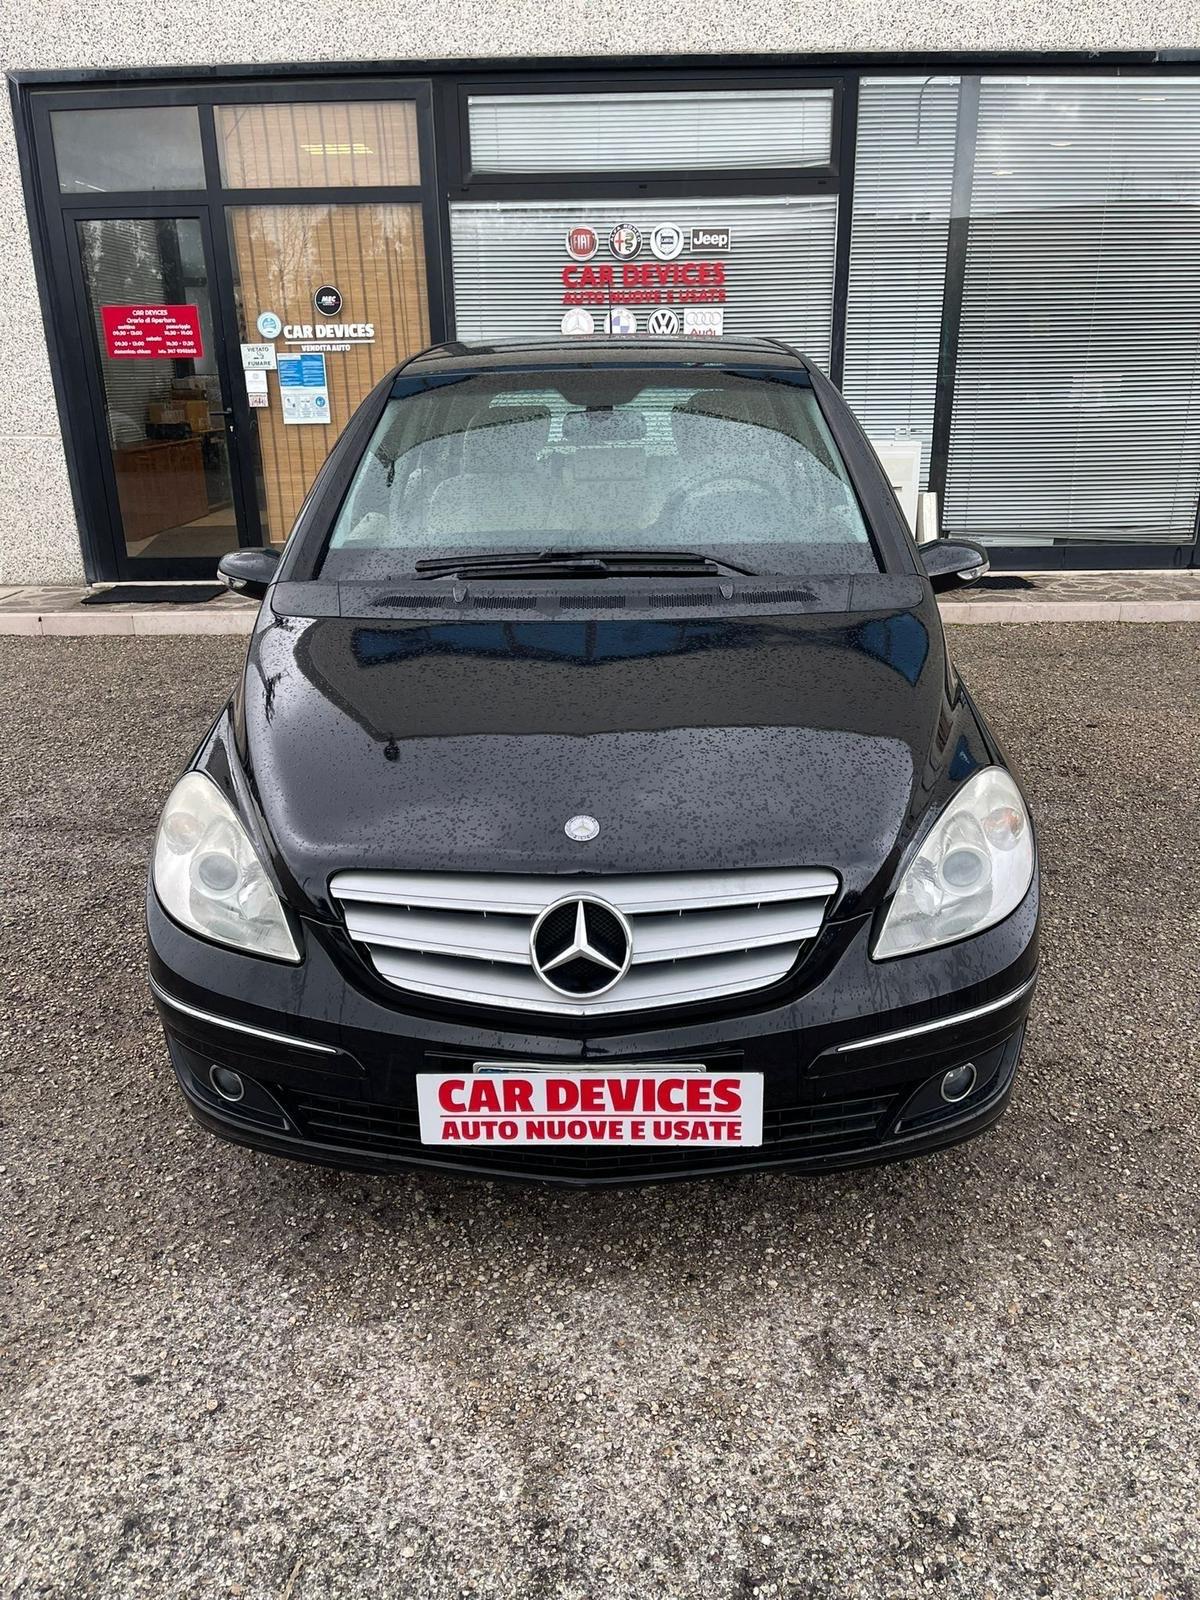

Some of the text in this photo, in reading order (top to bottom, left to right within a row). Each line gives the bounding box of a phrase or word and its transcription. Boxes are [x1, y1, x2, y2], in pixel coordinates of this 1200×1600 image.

[573, 234, 591, 250] FIAT
[693, 230, 728, 247] Jeep
[562, 262, 726, 288] CAR DEVICES
[562, 289, 727, 304] AUTO NUOVE E USATE
[283, 324, 314, 339] CAR
[315, 323, 375, 338] DEVICES
[301, 344, 351, 352] VENDITA AUTO
[438, 1079, 742, 1112] CAR DEVICES
[441, 1120, 742, 1140] AUTO NUOVE E USATE
